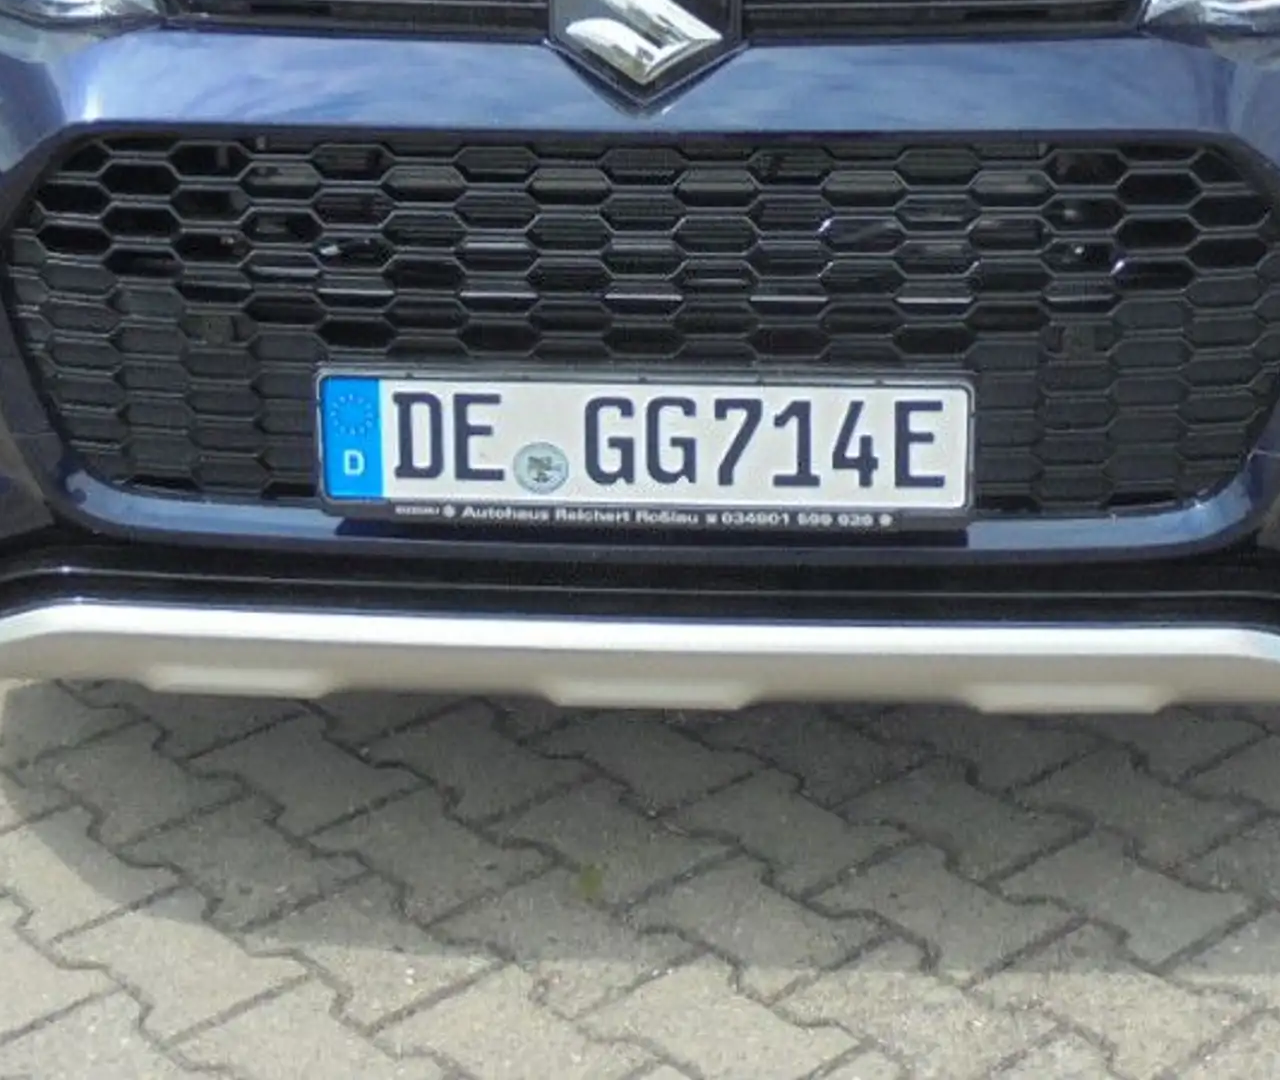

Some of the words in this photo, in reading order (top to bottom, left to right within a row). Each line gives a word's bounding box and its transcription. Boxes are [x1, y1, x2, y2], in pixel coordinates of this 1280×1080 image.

[392, 391, 505, 482] DE
[583, 395, 947, 489] GG714E
[343, 450, 365, 475] D
[462, 505, 549, 520] Autohaus
[556, 508, 630, 523] Reichert
